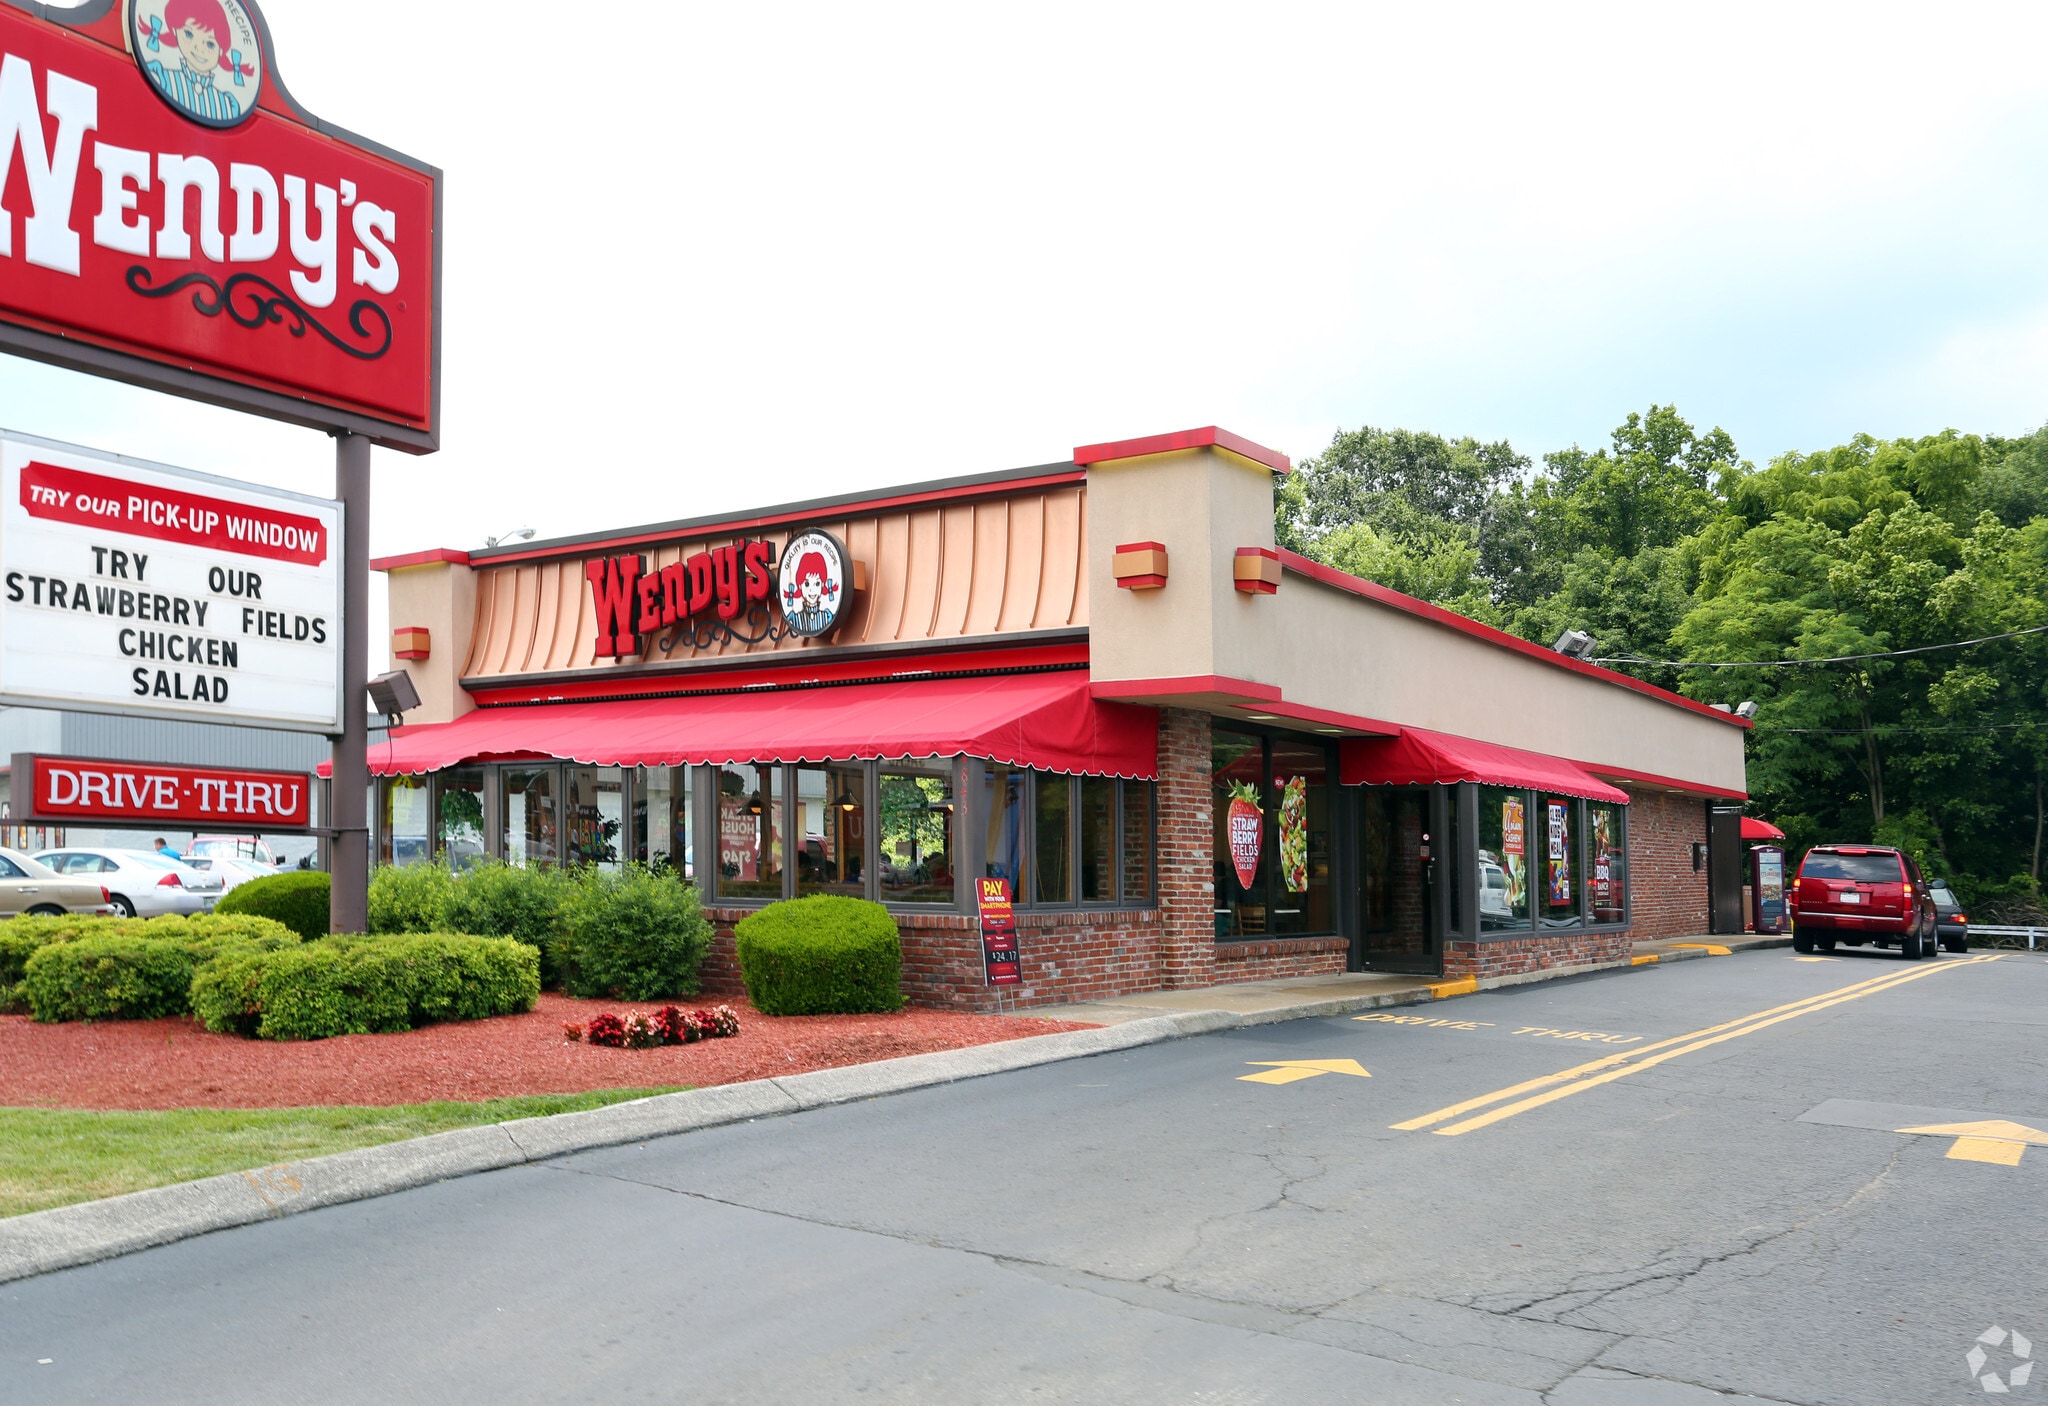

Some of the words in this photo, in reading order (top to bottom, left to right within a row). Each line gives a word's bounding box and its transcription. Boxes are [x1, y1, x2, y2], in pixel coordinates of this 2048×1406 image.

[225, 1, 252, 46] RECIPE
[30, 484, 71, 508] TRY
[75, 494, 121, 518] OUR
[128, 495, 219, 535] PICK-UP
[225, 514, 318, 553] WINDOW
[784, 543, 801, 570] QUALITY
[811, 538, 822, 547] OUR
[824, 543, 838, 567] RECIPE
[91, 545, 148, 581] TRY
[208, 566, 262, 600] OUR
[6, 571, 209, 627] STRAWBERRY
[242, 607, 326, 644] FIELDS
[119, 628, 238, 669] CHICKEN
[132, 667, 228, 703] SALAD
[1232, 817, 1258, 831] STRAW
[1232, 831, 1258, 845] BERRY
[1232, 844, 1259, 856] FIELDS
[983, 880, 1003, 896] PAY
[1596, 865, 1609, 881] BBQ
[1351, 1013, 1497, 1031] DRIVE
[1511, 1026, 1645, 1044] THRU
